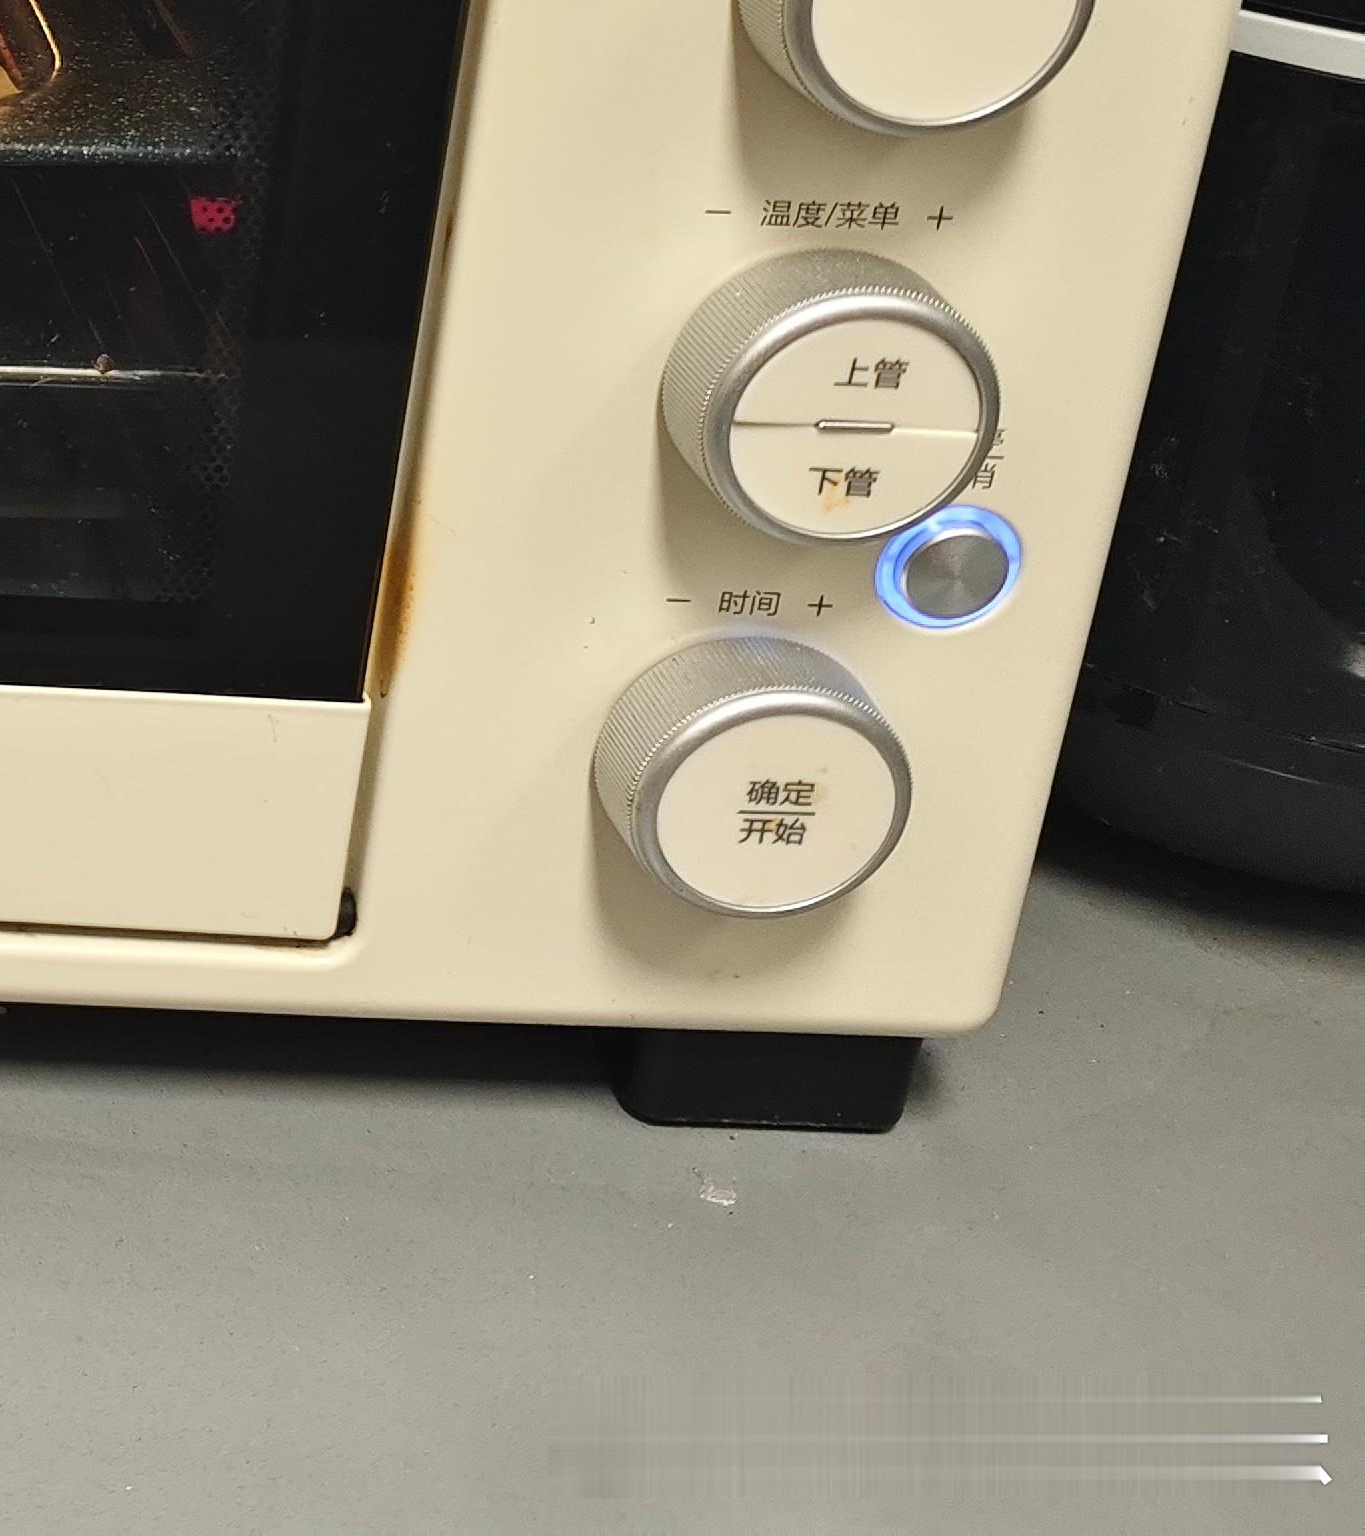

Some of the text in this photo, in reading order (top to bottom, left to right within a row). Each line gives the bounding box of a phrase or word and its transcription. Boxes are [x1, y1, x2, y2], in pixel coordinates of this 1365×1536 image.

[759, 199, 901, 230] 温度/菜单
[833, 357, 910, 391] 上管
[808, 466, 881, 498] 下管
[717, 590, 781, 616] 时间
[745, 779, 816, 807] 确定
[738, 817, 808, 846] 开始
